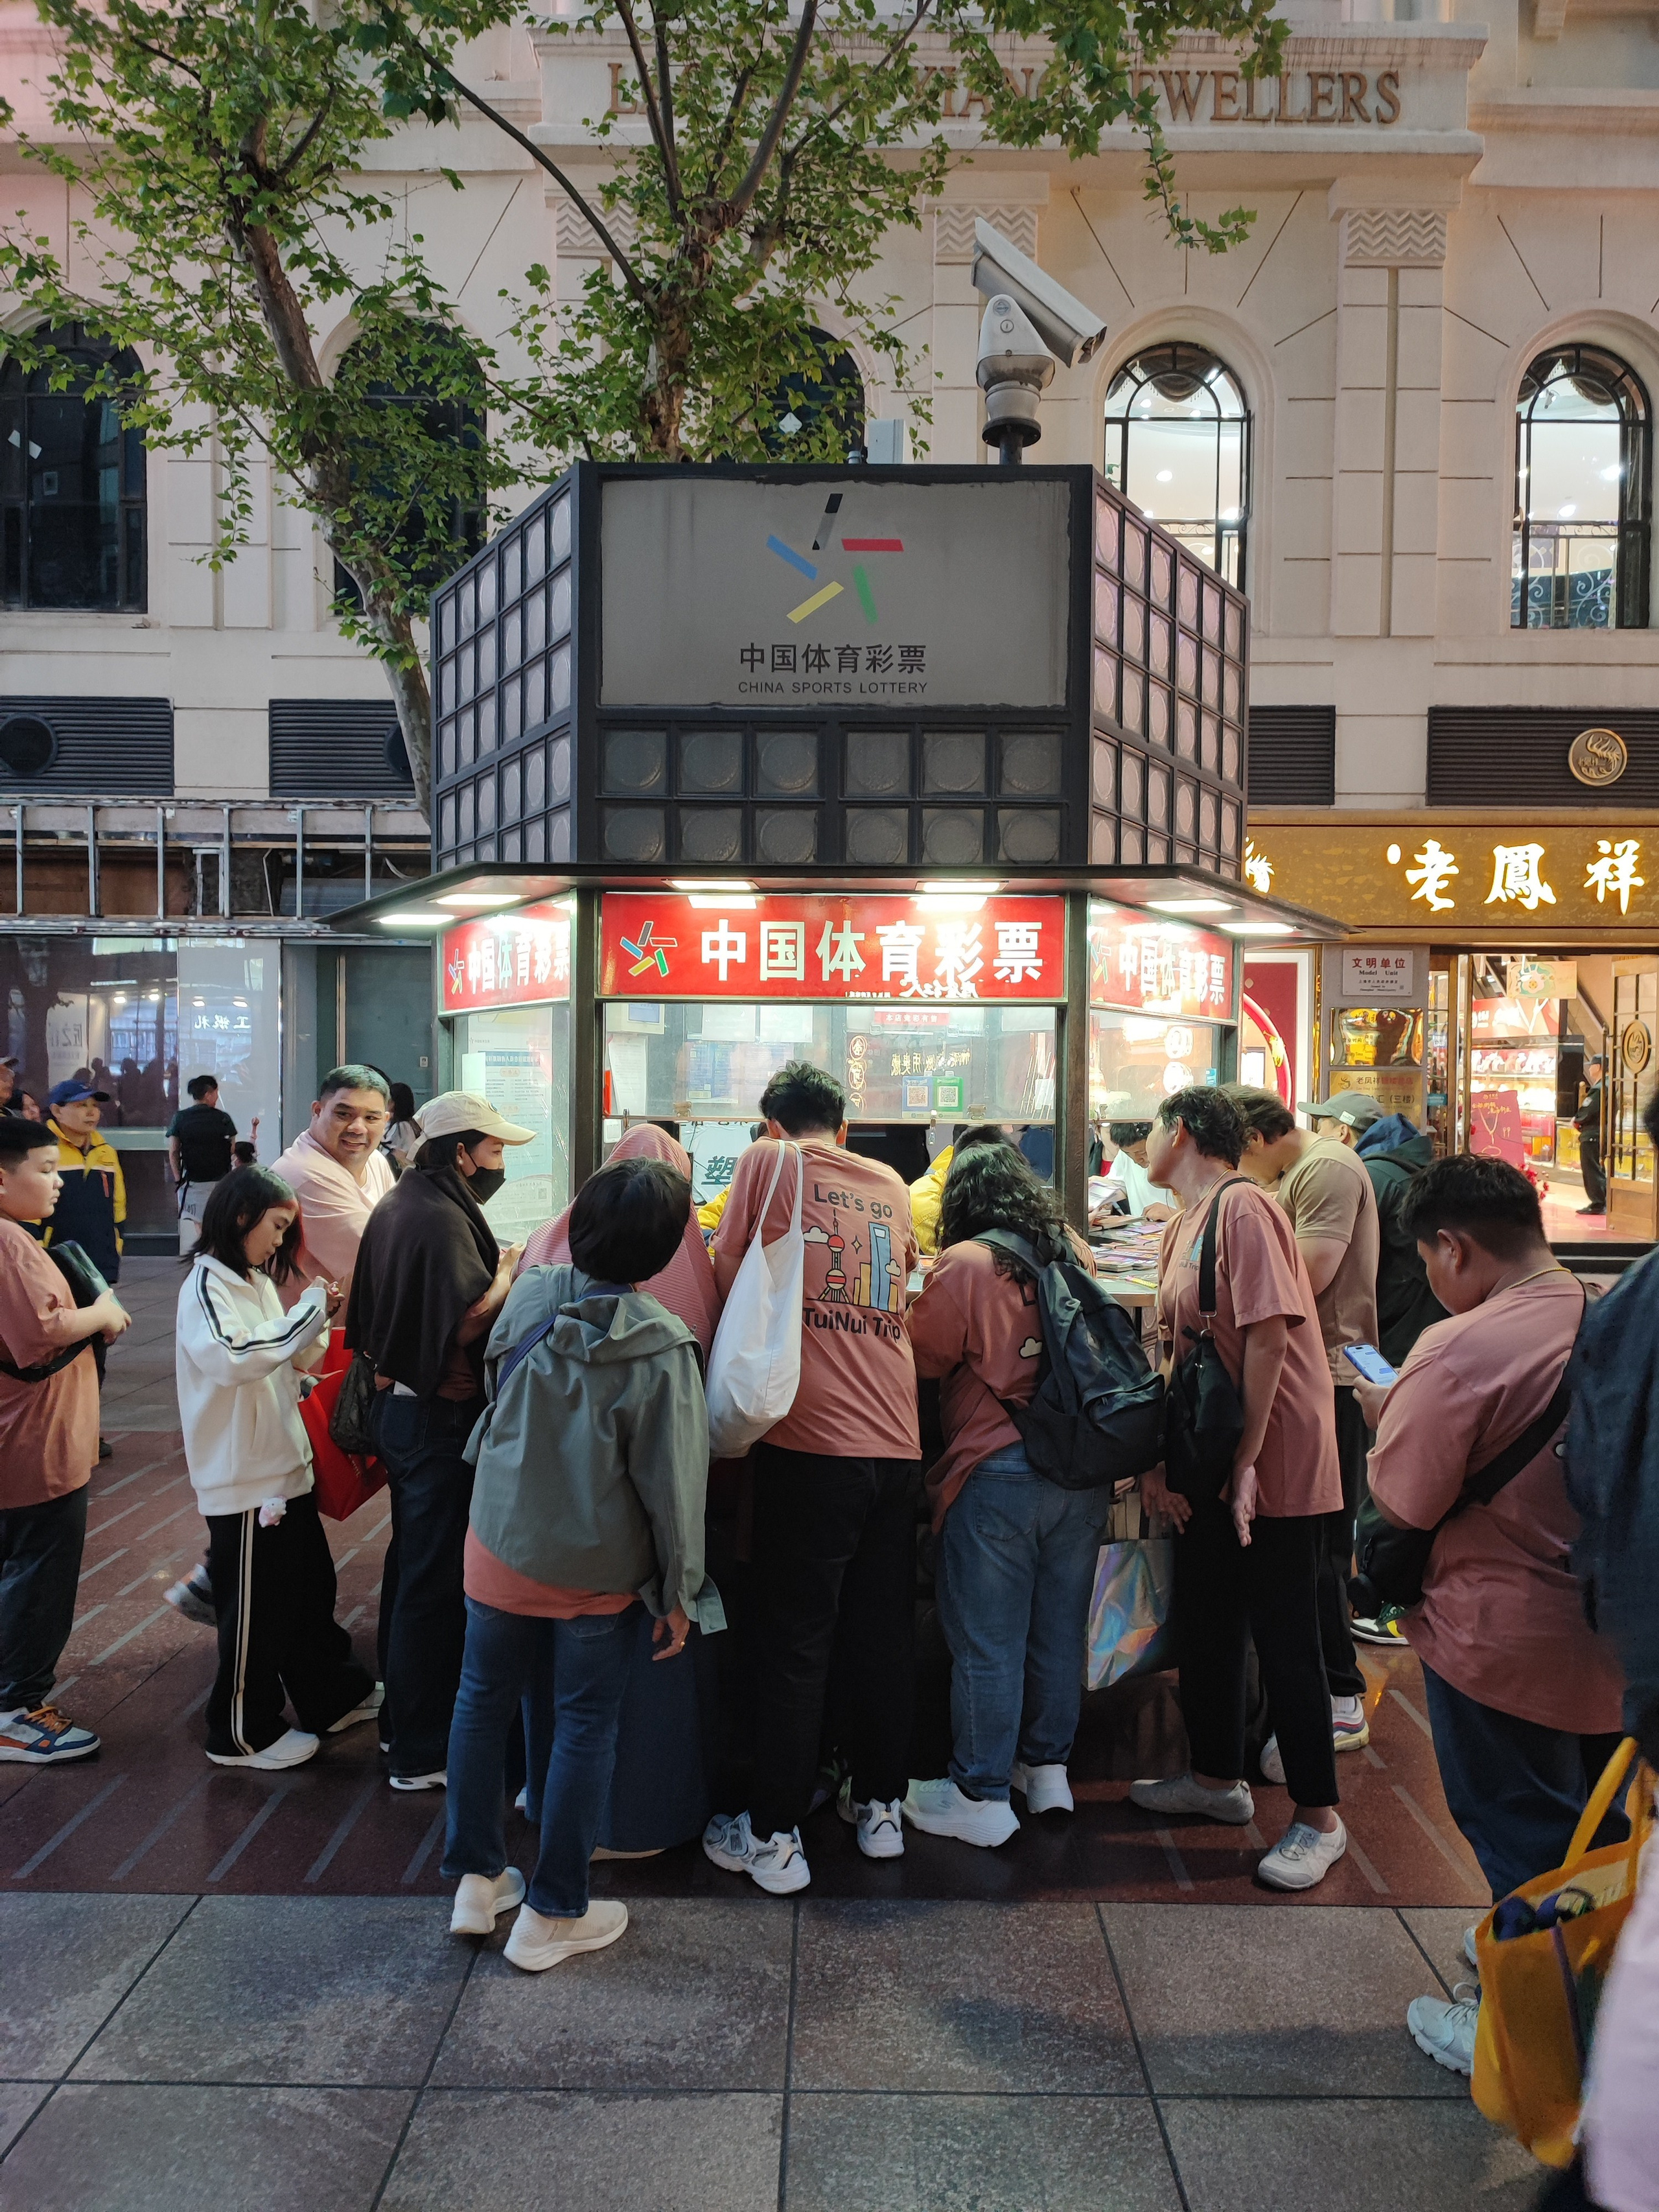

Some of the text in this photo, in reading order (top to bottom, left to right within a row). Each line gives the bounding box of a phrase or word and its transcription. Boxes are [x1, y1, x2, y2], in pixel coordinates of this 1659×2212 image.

[1112, 69, 1401, 124] EWELLERS
[740, 642, 926, 673] 中国体育彩票
[738, 681, 927, 693] CHINA SPORTS LOTTERY
[1406, 839, 1645, 915] 老鳳祥
[701, 919, 1043, 983] 中国体育彩票
[1119, 932, 1225, 1005] 中国体育彩票
[1352, 958, 1406, 968] 文明单位
[814, 1184, 893, 1219] Let's go
[803, 1307, 901, 1344] TuiNui Trip
